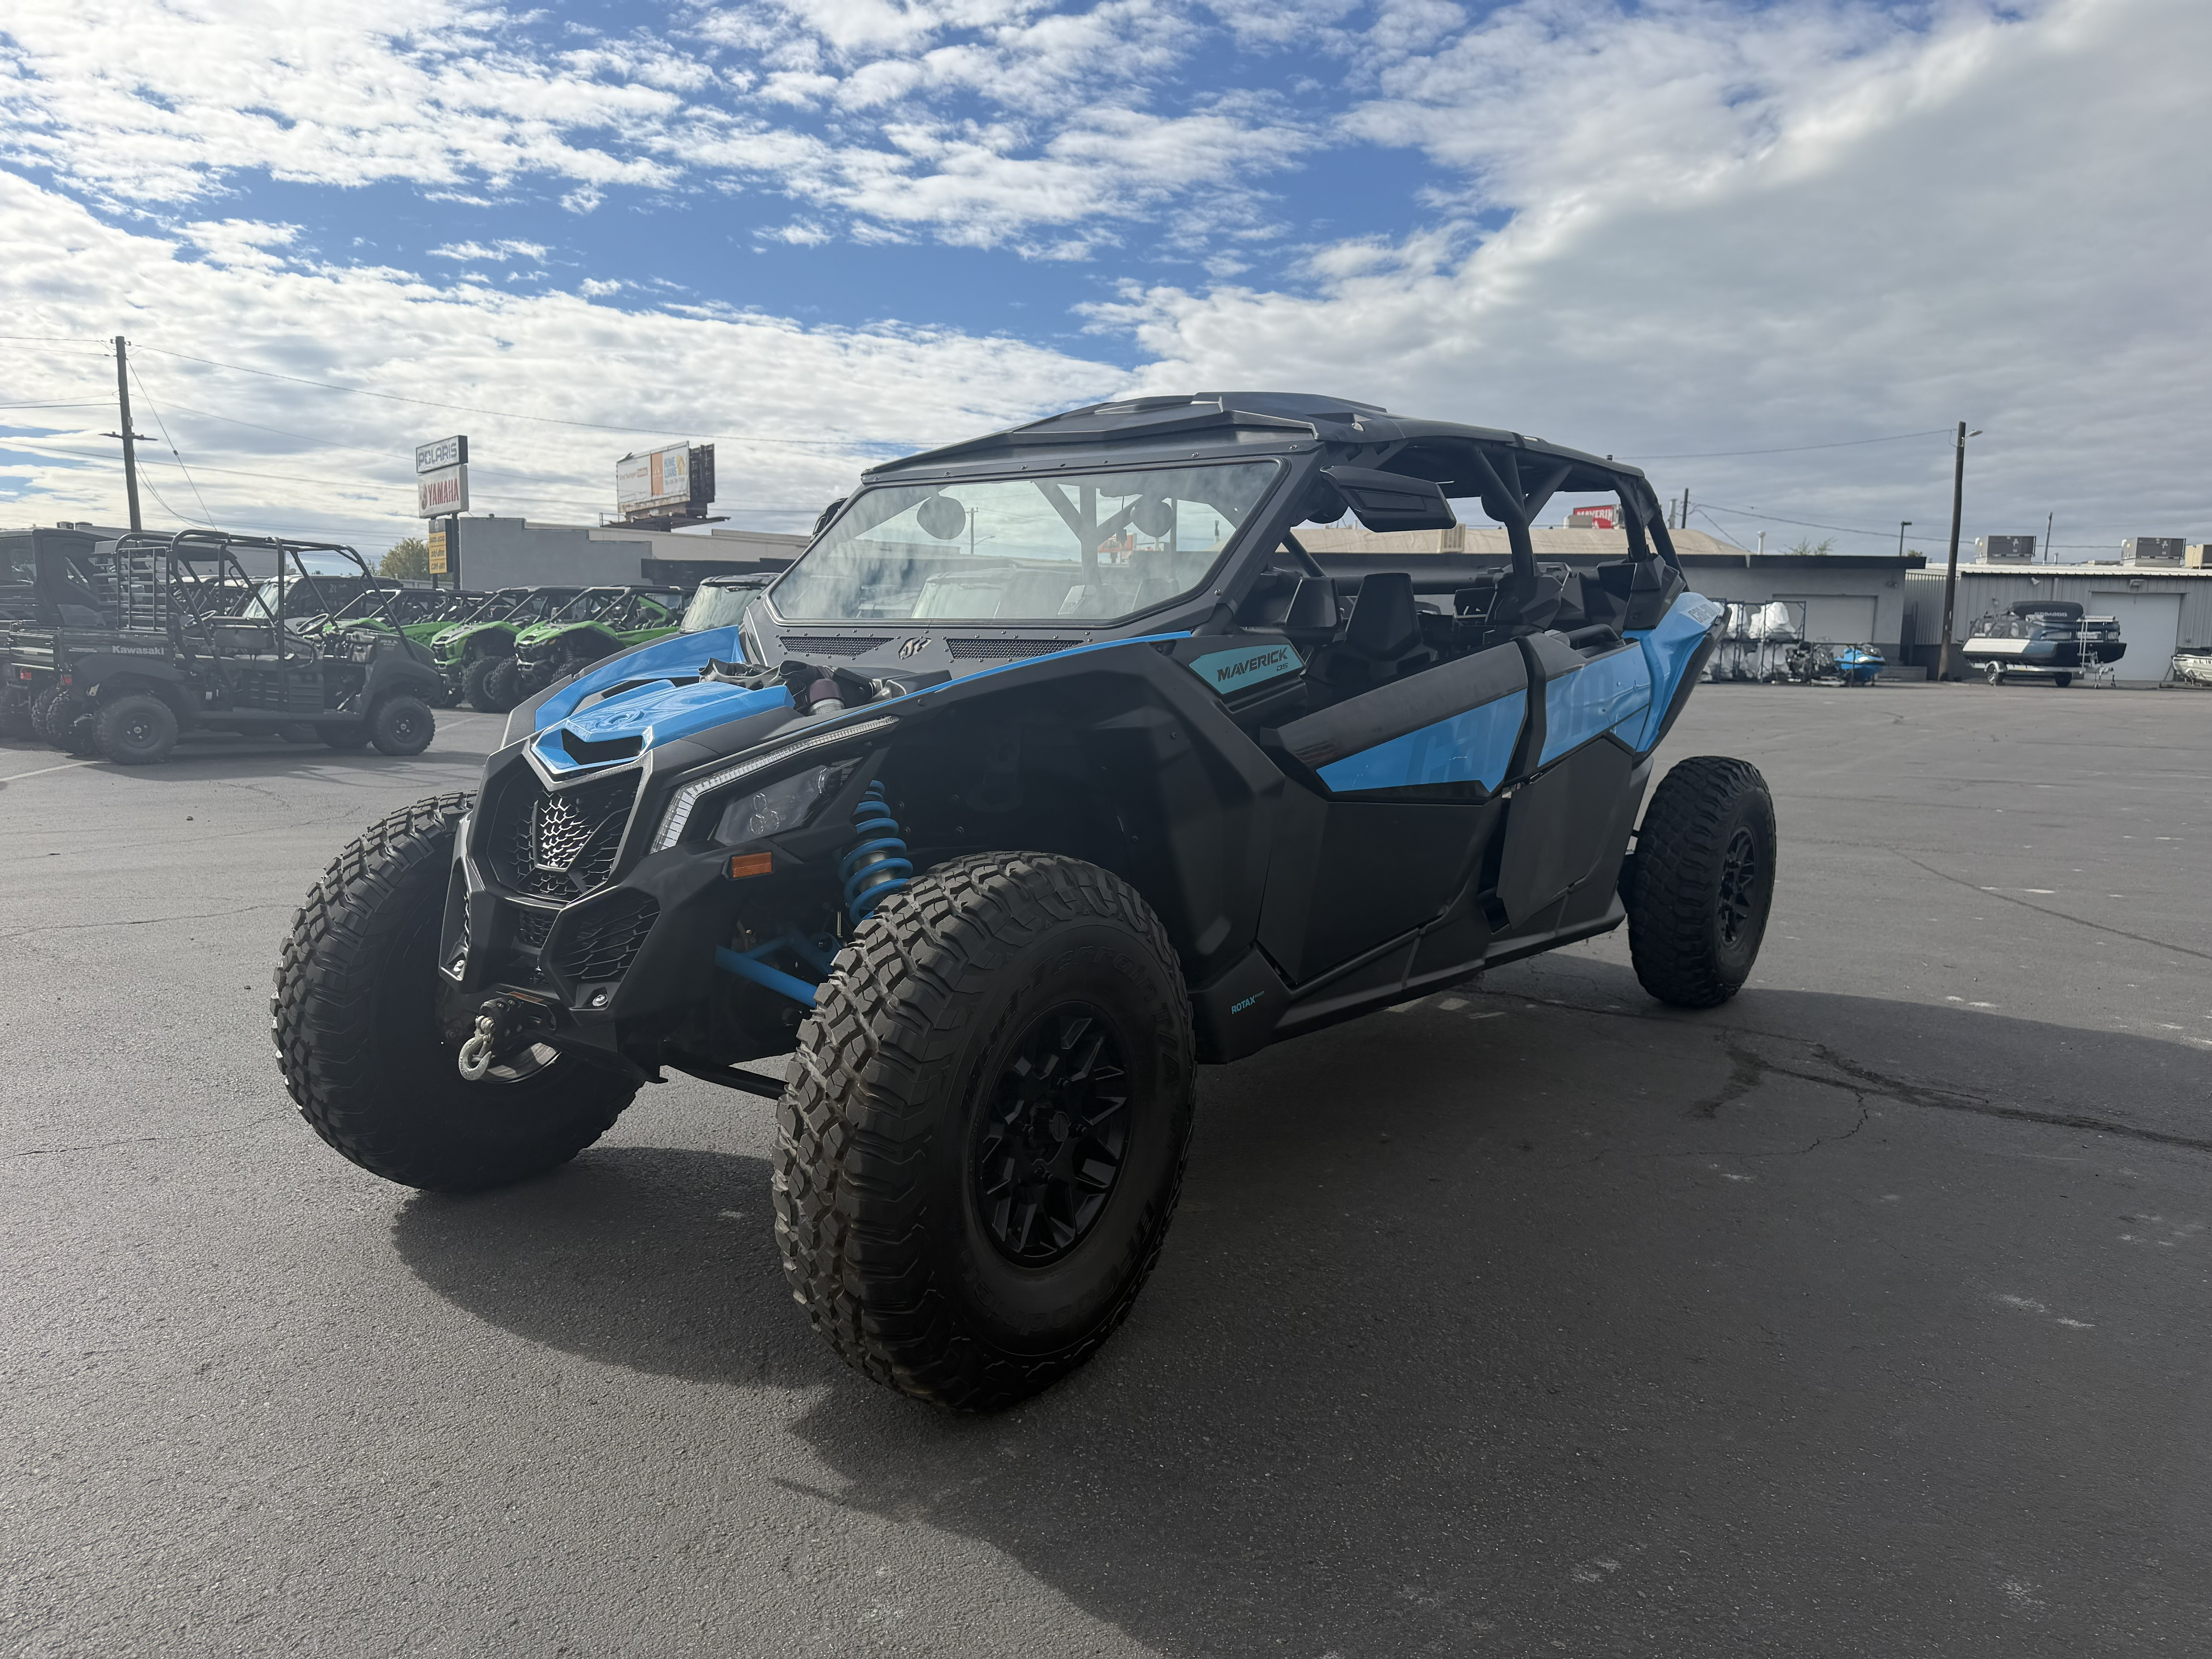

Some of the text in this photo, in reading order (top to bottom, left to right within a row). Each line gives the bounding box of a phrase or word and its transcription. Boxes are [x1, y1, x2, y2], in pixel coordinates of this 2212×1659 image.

[418, 443, 457, 466] POLARIS
[665, 466, 677, 478] LOANS
[428, 478, 459, 506] YAMAHA
[112, 645, 164, 655] Kawasaki
[1217, 647, 1288, 682] MAVERICK
[1231, 995, 1255, 1014] ROTAX
